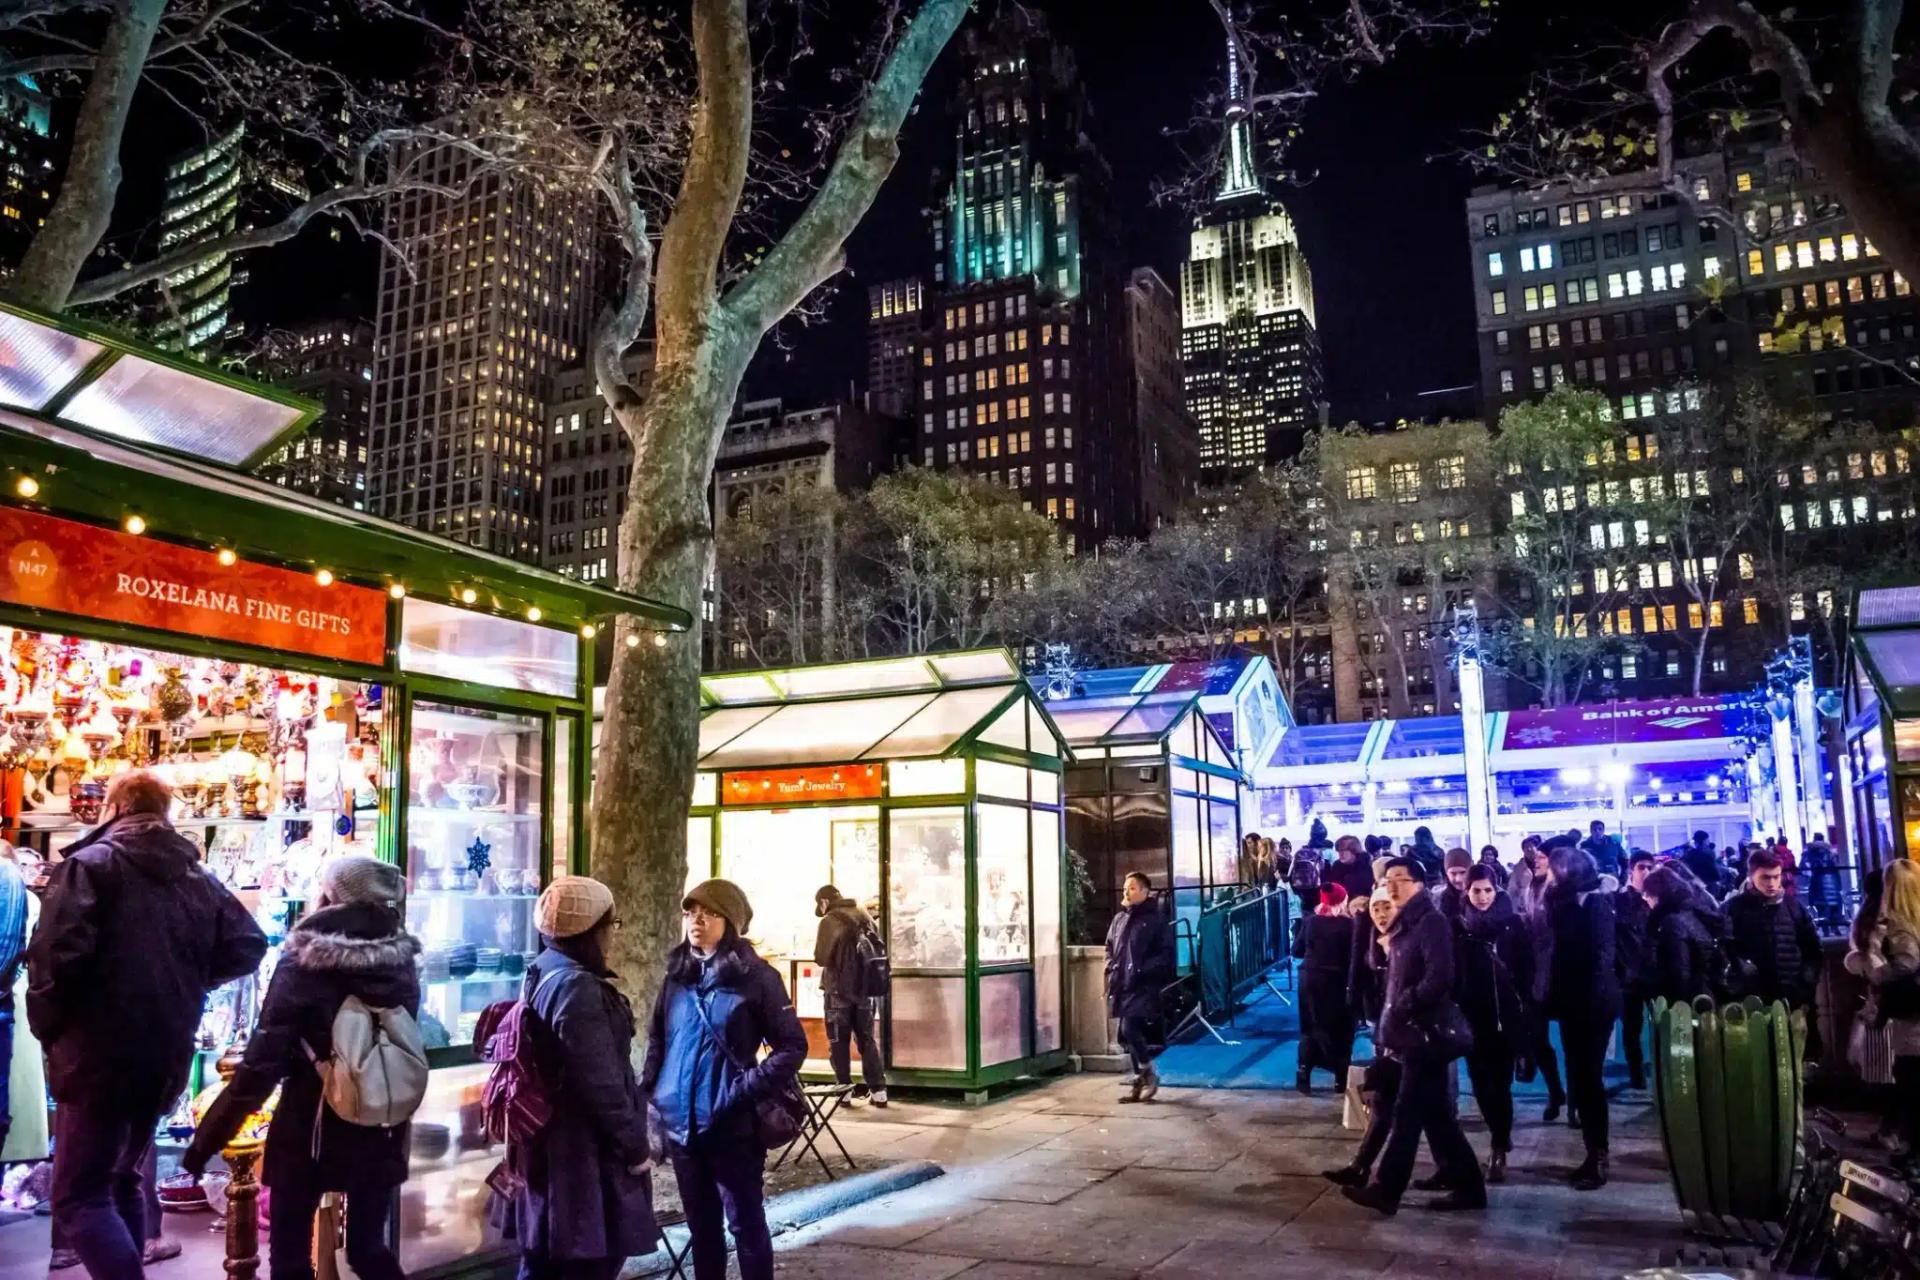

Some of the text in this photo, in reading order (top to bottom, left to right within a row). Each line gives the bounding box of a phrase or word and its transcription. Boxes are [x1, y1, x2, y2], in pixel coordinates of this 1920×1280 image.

[18, 560, 48, 577] N47
[116, 573, 351, 636] ROXELANA FINE GIFTS
[1582, 700, 1766, 721] Bank of Americ
[806, 780, 846, 792] Jewelry
